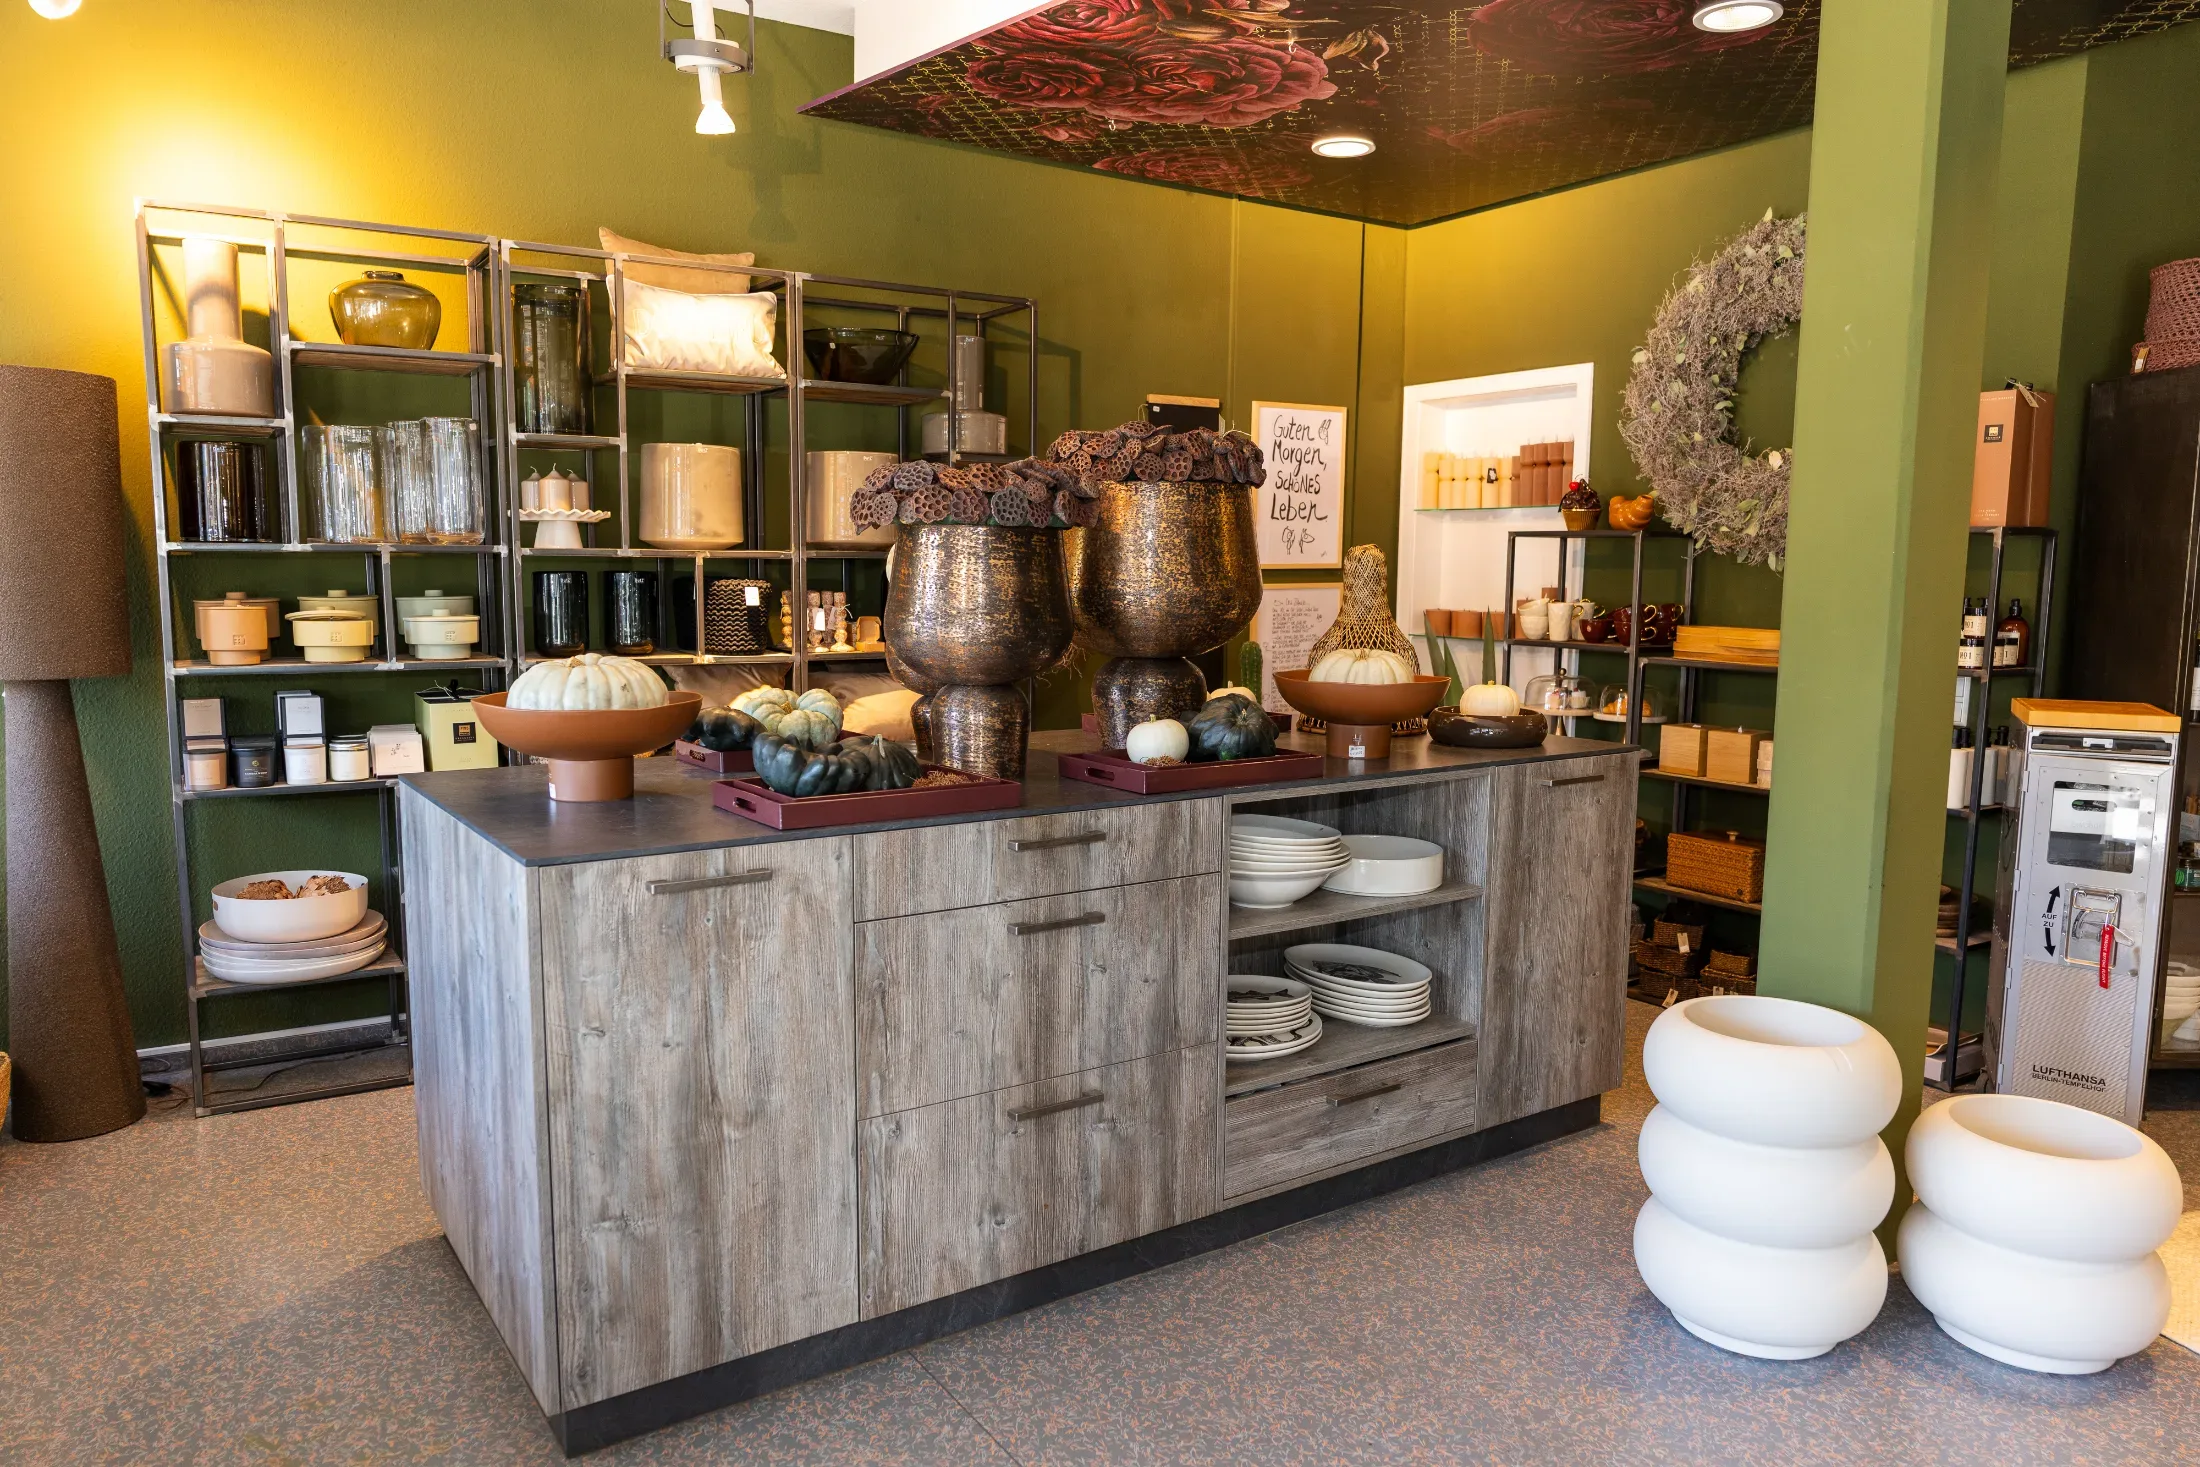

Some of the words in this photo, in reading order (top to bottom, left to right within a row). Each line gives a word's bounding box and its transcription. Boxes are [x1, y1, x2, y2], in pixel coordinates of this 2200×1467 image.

[1273, 414, 1315, 441] Guten
[1272, 439, 1327, 477] Morgen,
[2043, 920, 2054, 928] ZU
[2032, 1064, 2106, 1086] LUFTHANSA
[2032, 1073, 2107, 1093] BERLIN-TEMPELHOF
